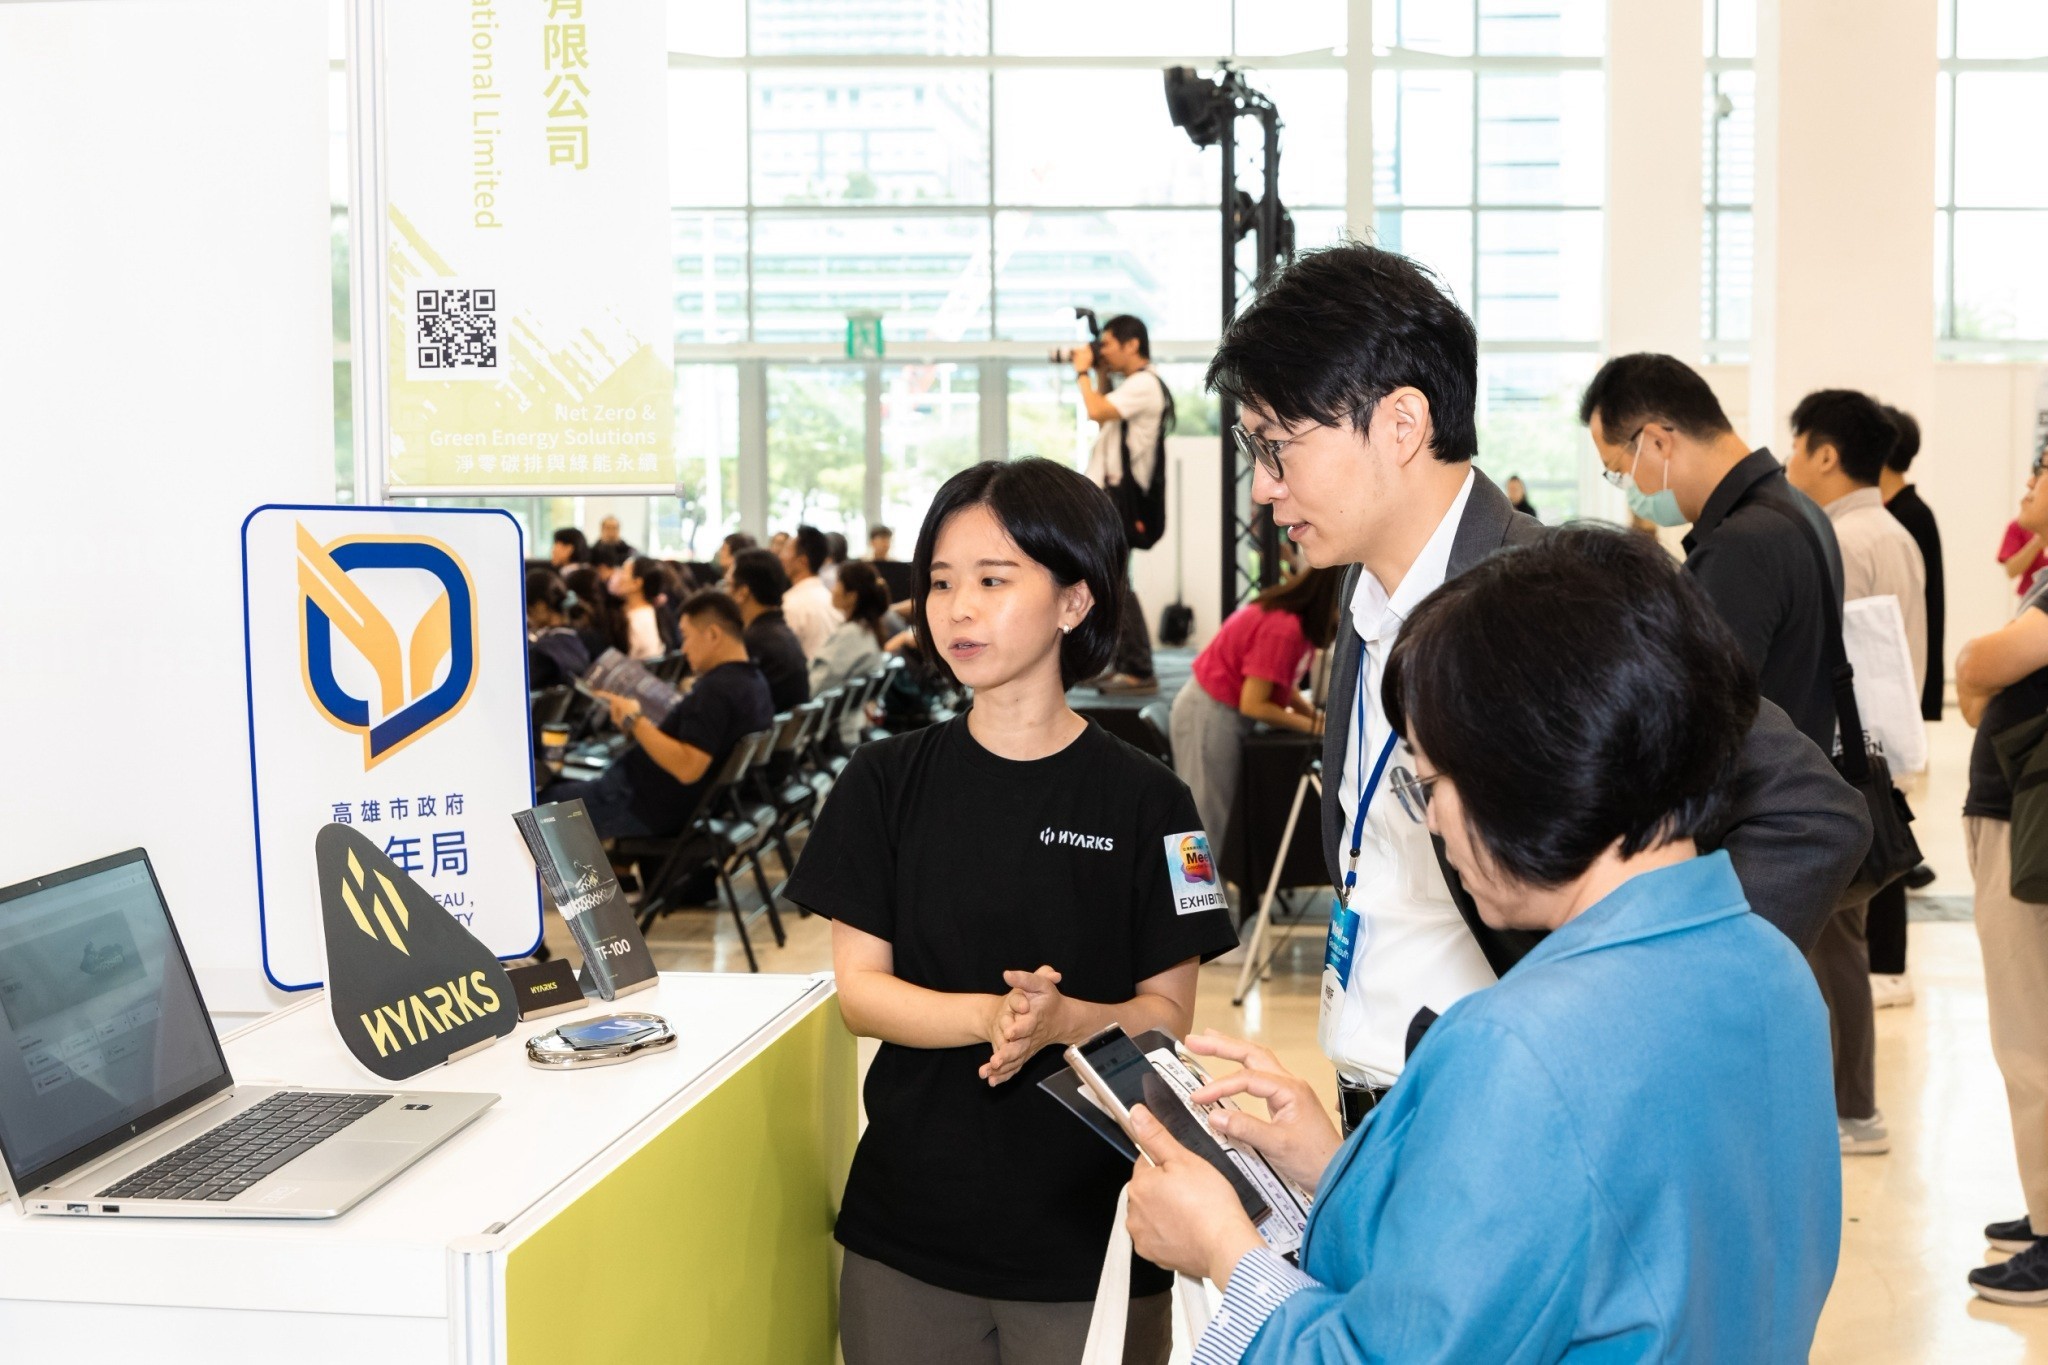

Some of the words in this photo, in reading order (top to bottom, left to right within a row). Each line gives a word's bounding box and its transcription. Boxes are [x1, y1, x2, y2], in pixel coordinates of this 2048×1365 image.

[473, 111, 503, 229] Limited
[555, 403, 588, 421] Net
[594, 404, 636, 421] Zero
[642, 404, 656, 421] &
[429, 430, 486, 446] Green
[492, 429, 559, 450] Energy
[564, 428, 656, 445] Solutions
[456, 453, 659, 473] 淨零碳排與綠能永續
[332, 793, 464, 824] 高雄市政府
[384, 831, 468, 877] 年局
[433, 892, 473, 907] EAU,
[454, 912, 473, 926] TY
[595, 939, 631, 960] TF-100
